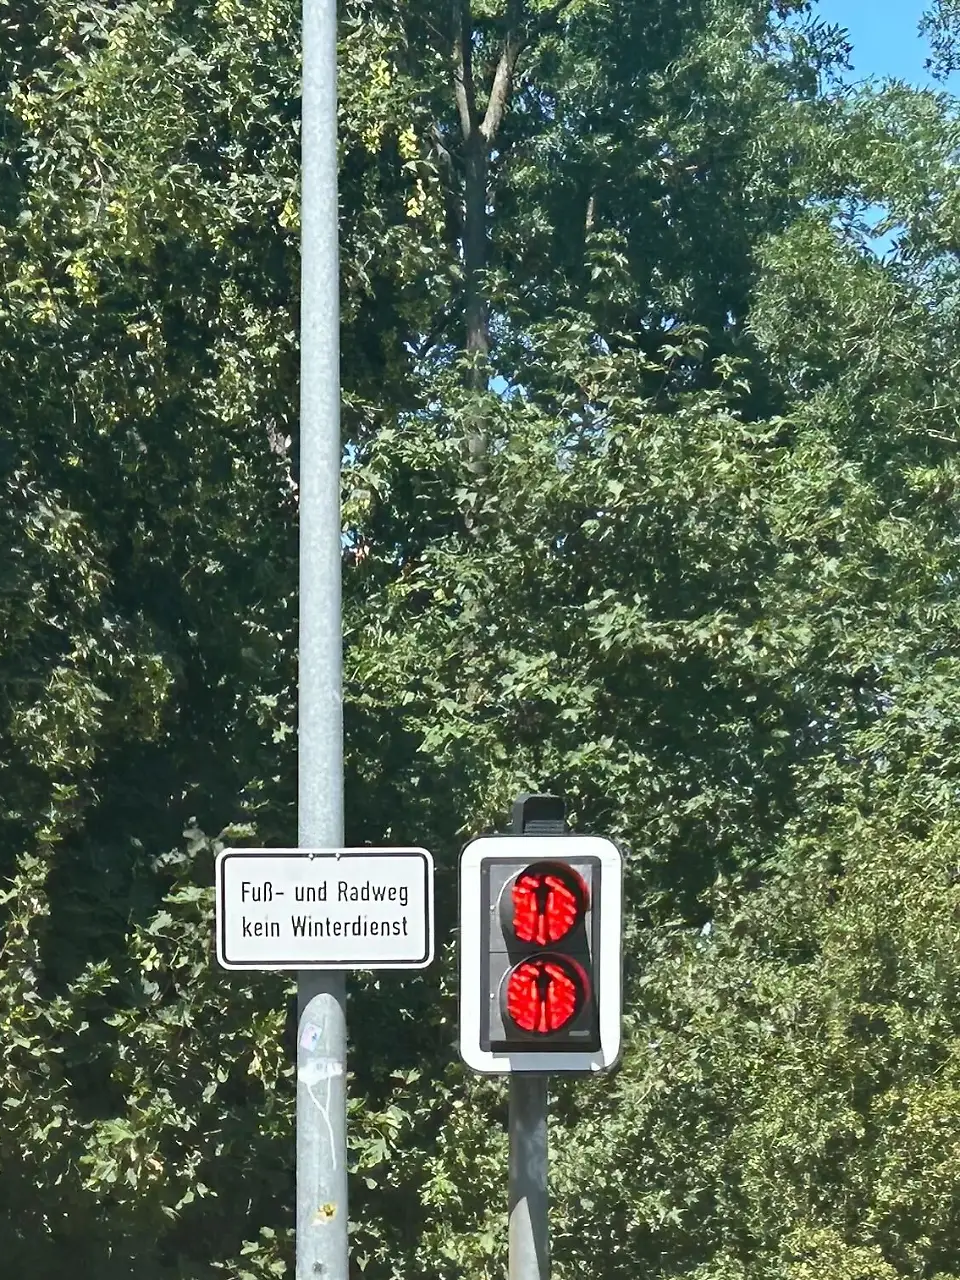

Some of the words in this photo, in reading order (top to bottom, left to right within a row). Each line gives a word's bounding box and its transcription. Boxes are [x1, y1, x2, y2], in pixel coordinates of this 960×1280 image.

[241, 881, 285, 903] Fuß-
[295, 880, 327, 902] und
[338, 880, 408, 907] Radweg
[242, 914, 280, 938] kein
[291, 914, 408, 938] Winterdienst
